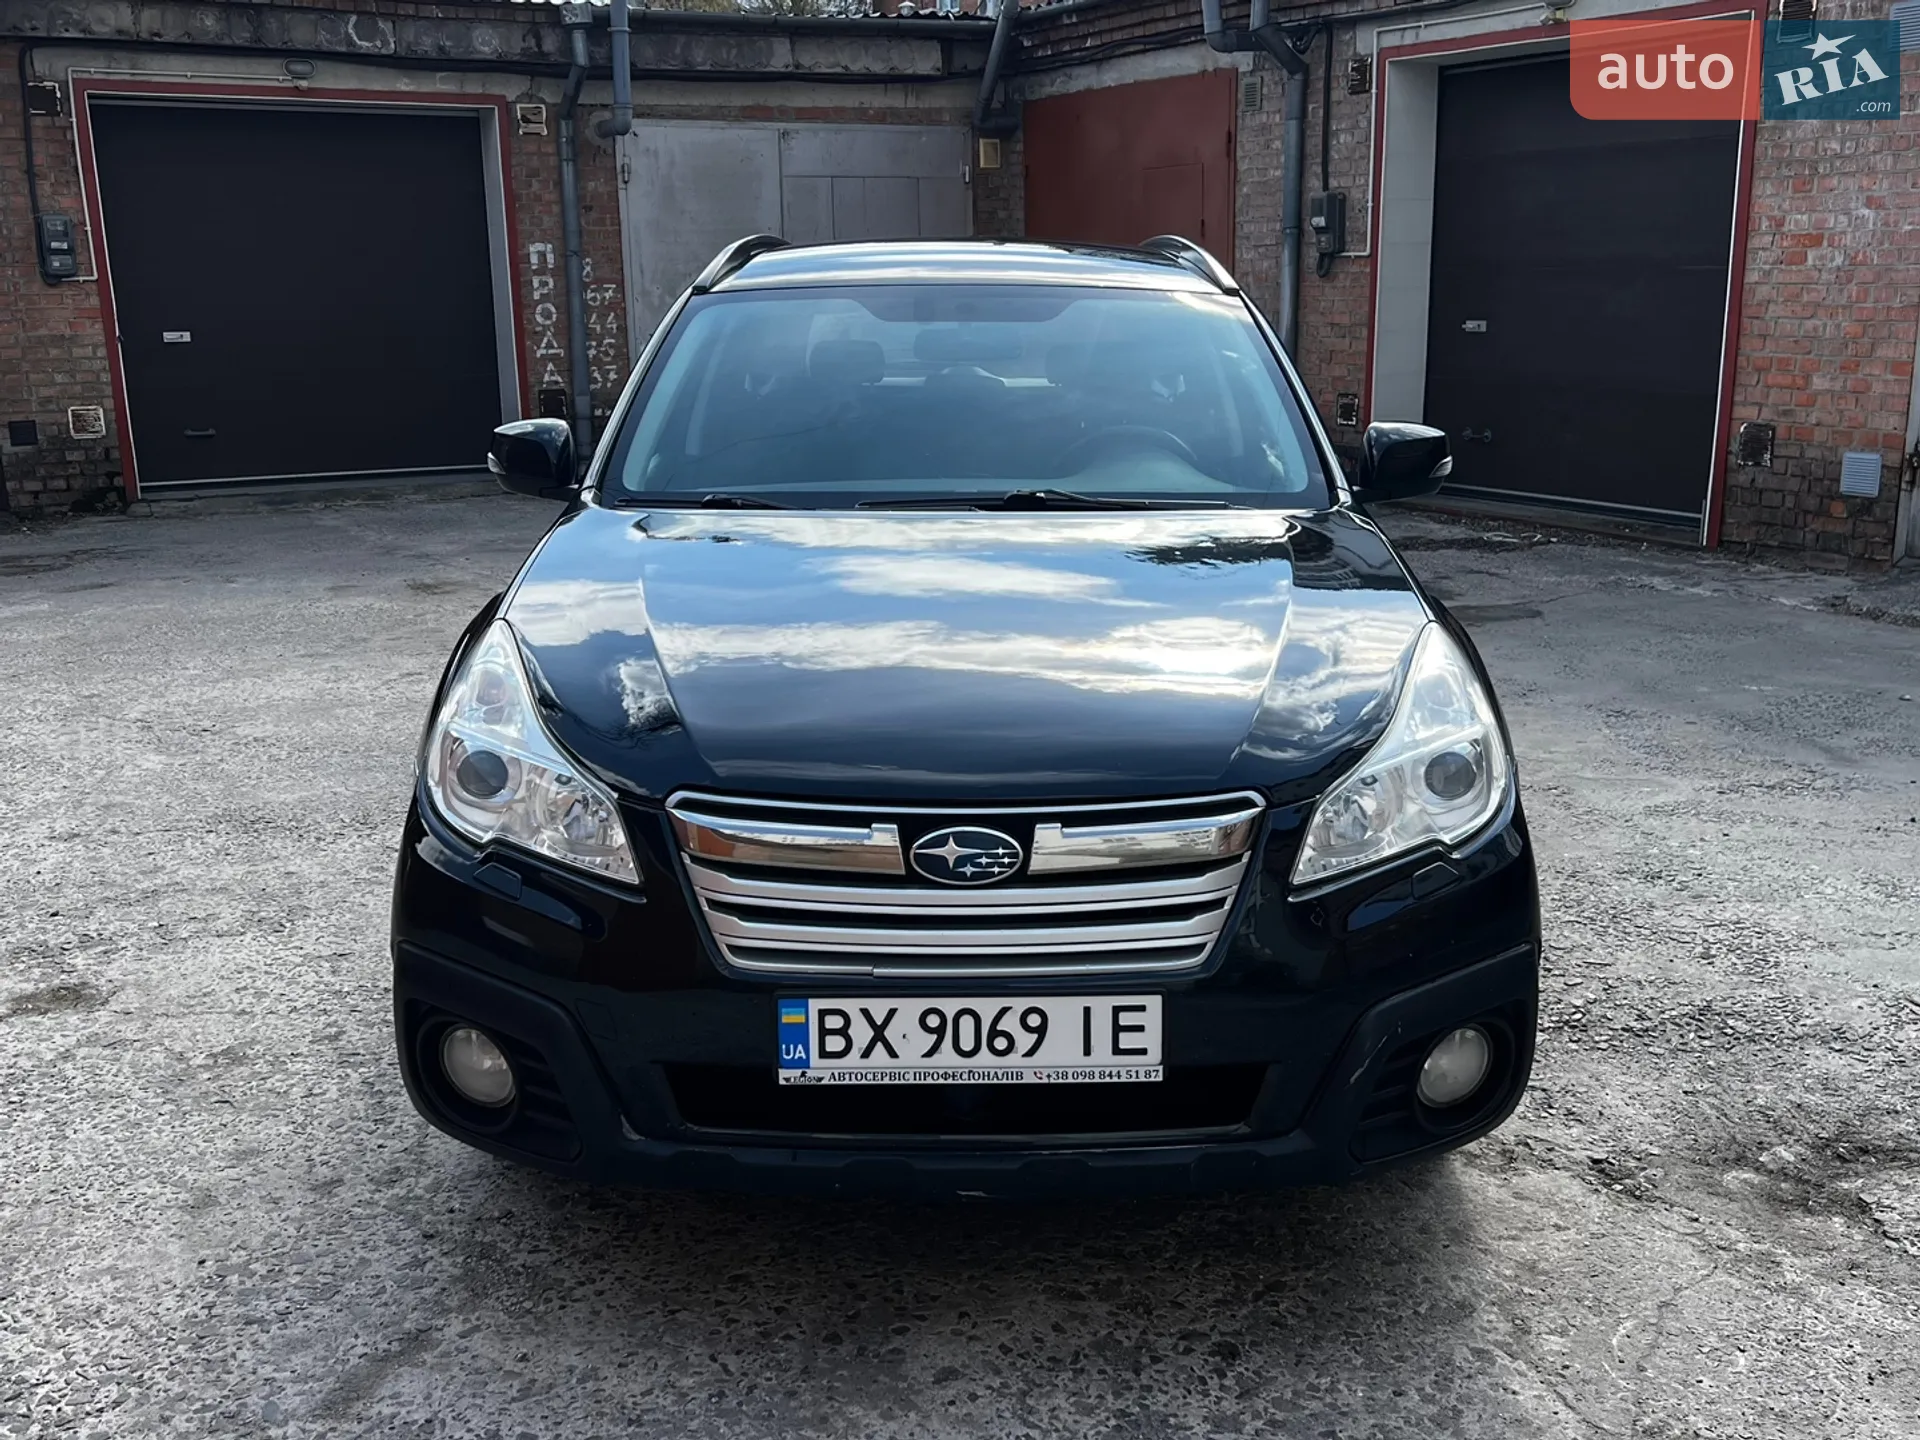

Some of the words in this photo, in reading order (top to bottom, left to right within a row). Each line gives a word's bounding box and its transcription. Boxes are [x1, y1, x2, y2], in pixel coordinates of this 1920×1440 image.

[918, 1006, 1049, 1058] 9069
[782, 1044, 806, 1060] UA
[828, 1071, 910, 1082] АВТОСЕРВІС
[1072, 1070, 1095, 1081] 098
[1098, 1070, 1122, 1080] 844
[1125, 1069, 1140, 1080] 51
[1144, 1069, 1160, 1079] 87
